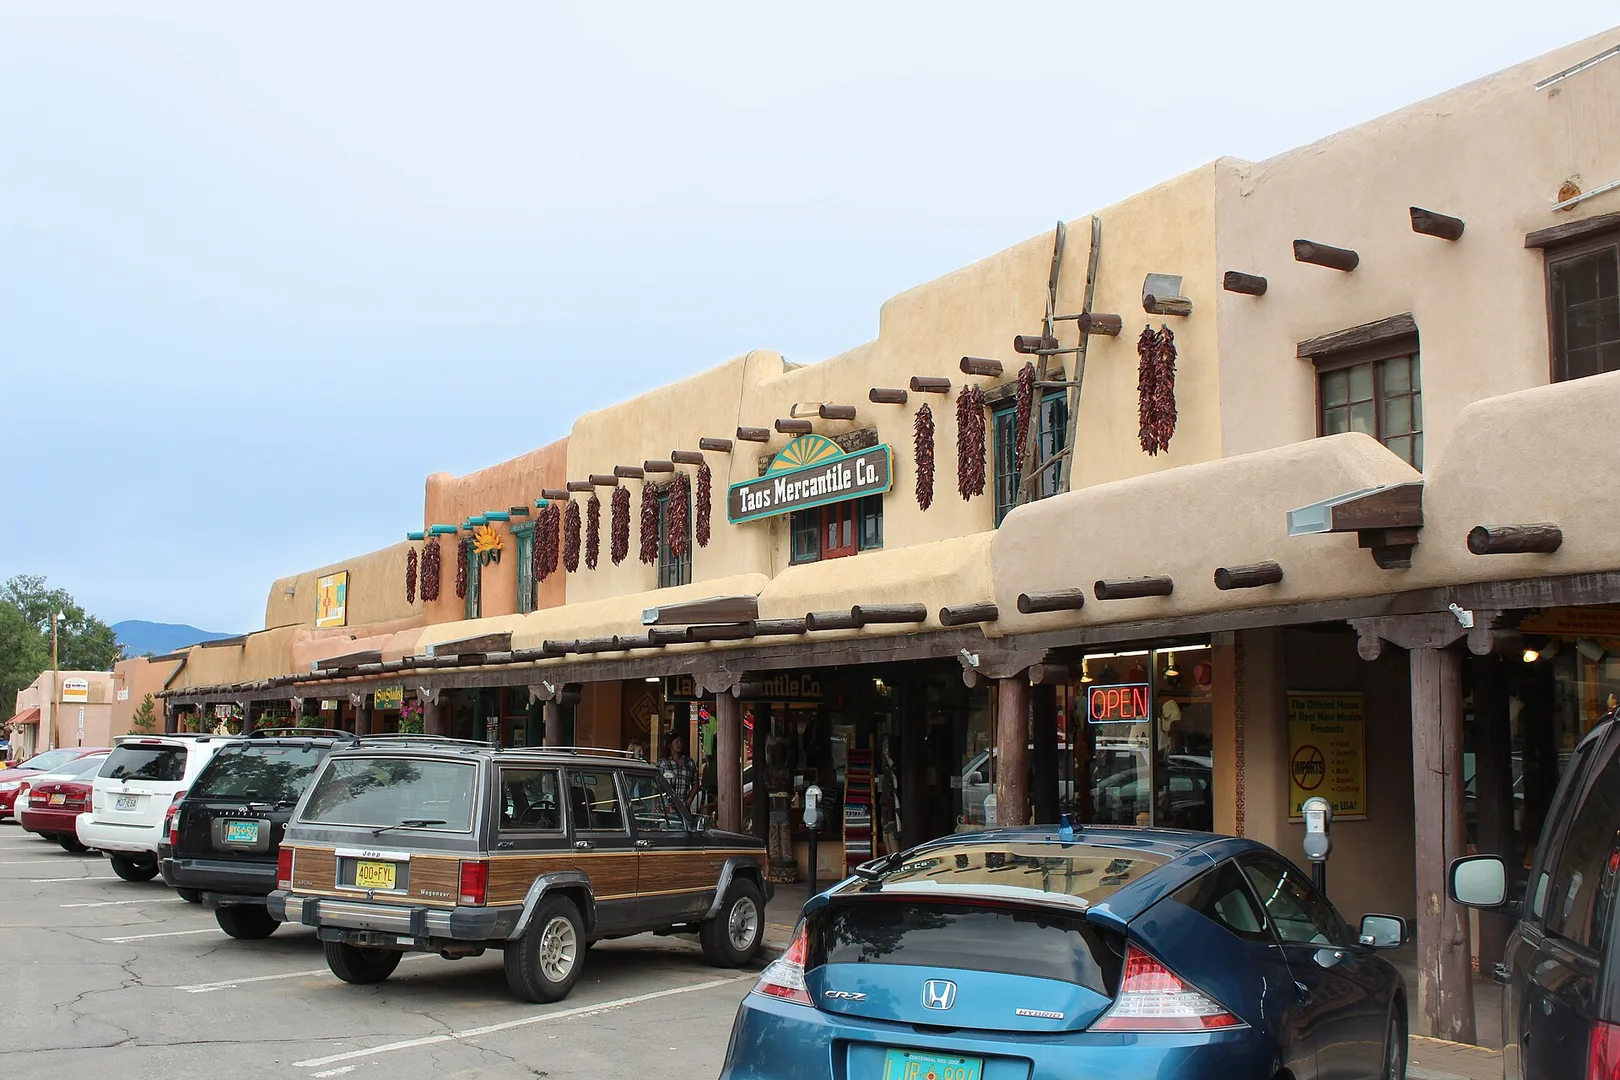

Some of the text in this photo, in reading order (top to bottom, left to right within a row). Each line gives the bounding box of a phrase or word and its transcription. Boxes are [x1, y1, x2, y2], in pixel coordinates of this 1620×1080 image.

[739, 457, 880, 514] Taos Mercantile Co.
[1090, 686, 1148, 719] OPEN
[1292, 699, 1359, 710] The Official Home
[1298, 711, 1316, 722] Real
[1317, 712, 1336, 722] New
[1337, 711, 1362, 722] Mexico
[1310, 723, 1344, 733] Products
[1294, 760, 1323, 775] IMPORTS
[1340, 801, 1357, 811] USA!
[362, 850, 381, 858] Jeep
[1017, 1009, 1063, 1019] HYBRID
[908, 1054, 937, 1064] CENTENNIAL
